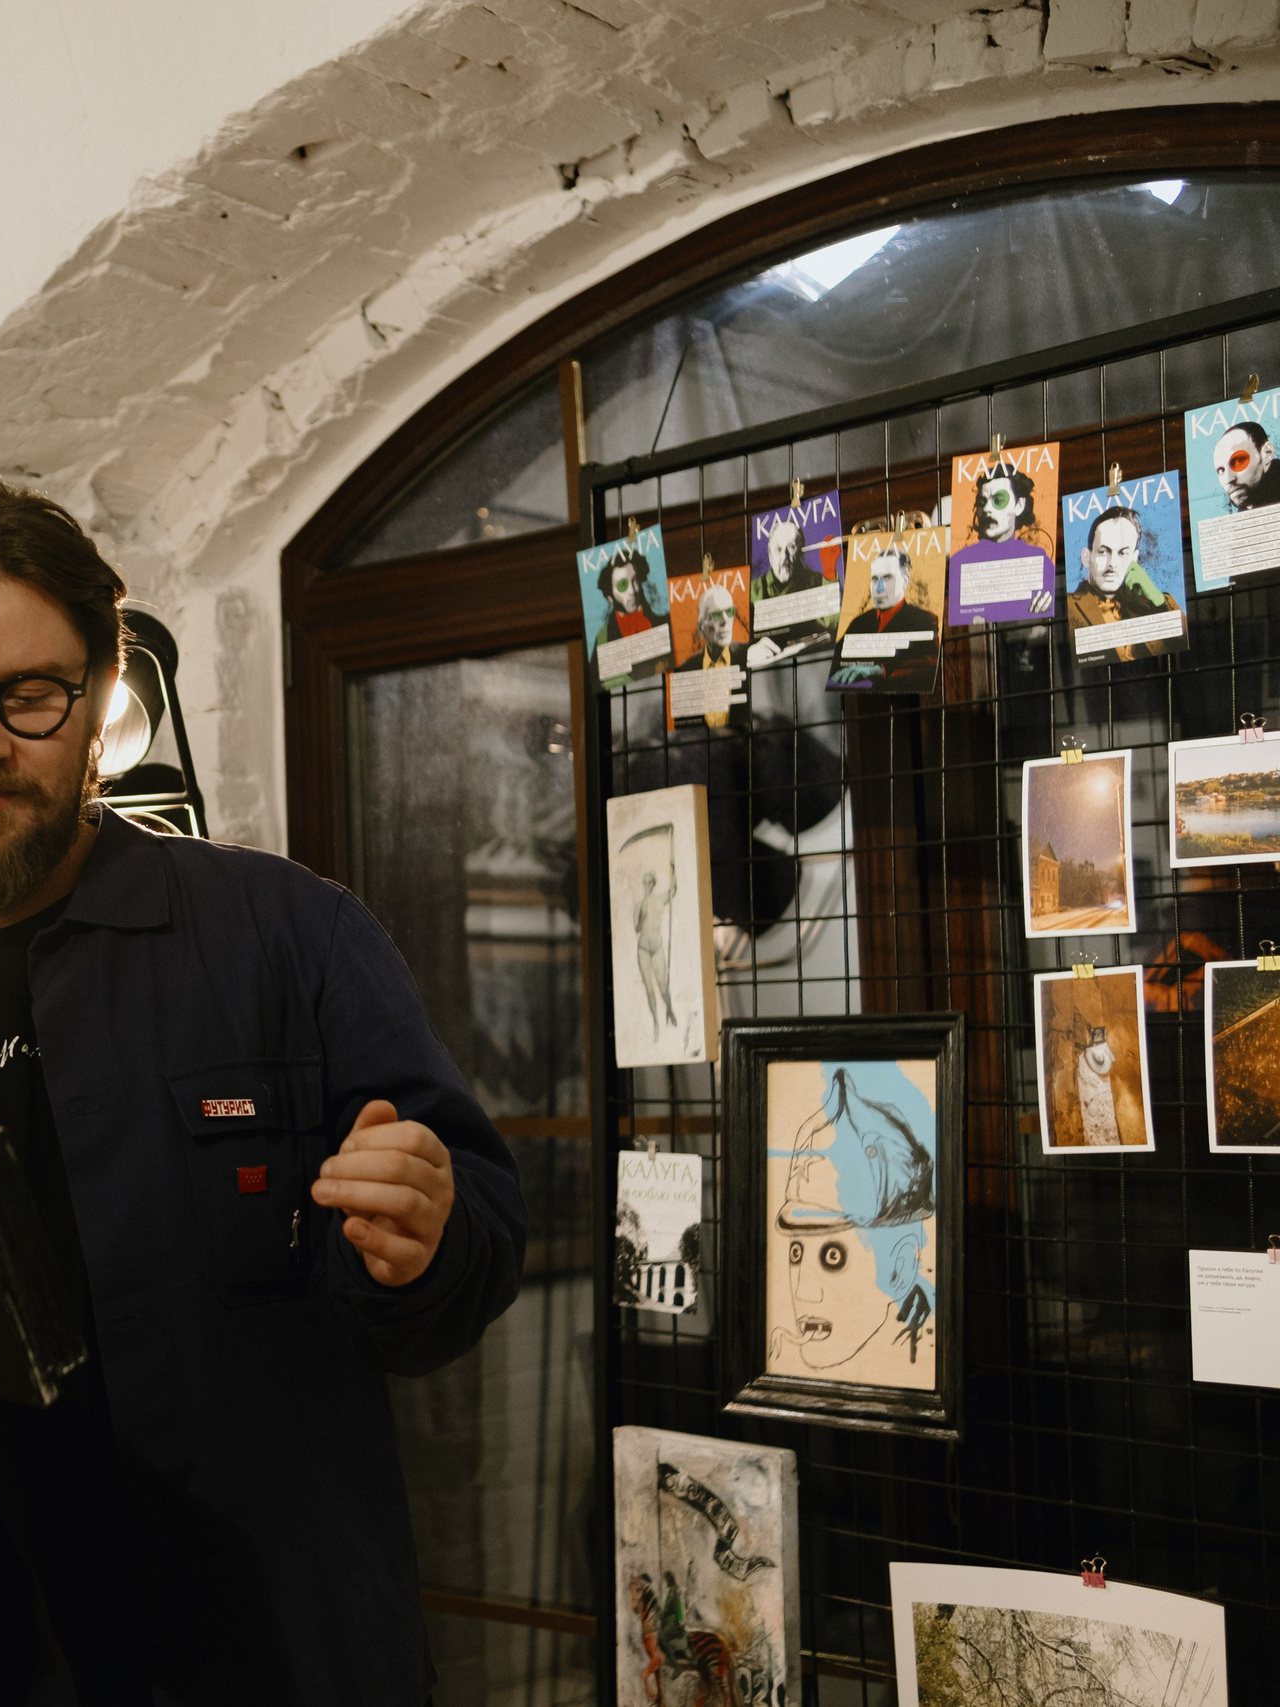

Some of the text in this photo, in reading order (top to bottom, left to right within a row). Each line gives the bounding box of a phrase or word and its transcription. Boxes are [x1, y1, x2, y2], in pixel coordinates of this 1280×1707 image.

[1192, 393, 1280, 439] КАЛУГ
[958, 446, 1054, 483] КАЛУГА
[756, 496, 836, 540] КАЛУГА
[1068, 476, 1174, 523] КАЛУГА
[582, 529, 660, 574] КАЛУГА
[853, 531, 942, 562] КАЛУГА
[670, 570, 746, 604] КАЛУГА
[202, 1100, 255, 1116] ФУТУРИСТ
[621, 1160, 698, 1187] КАЛУГА,
